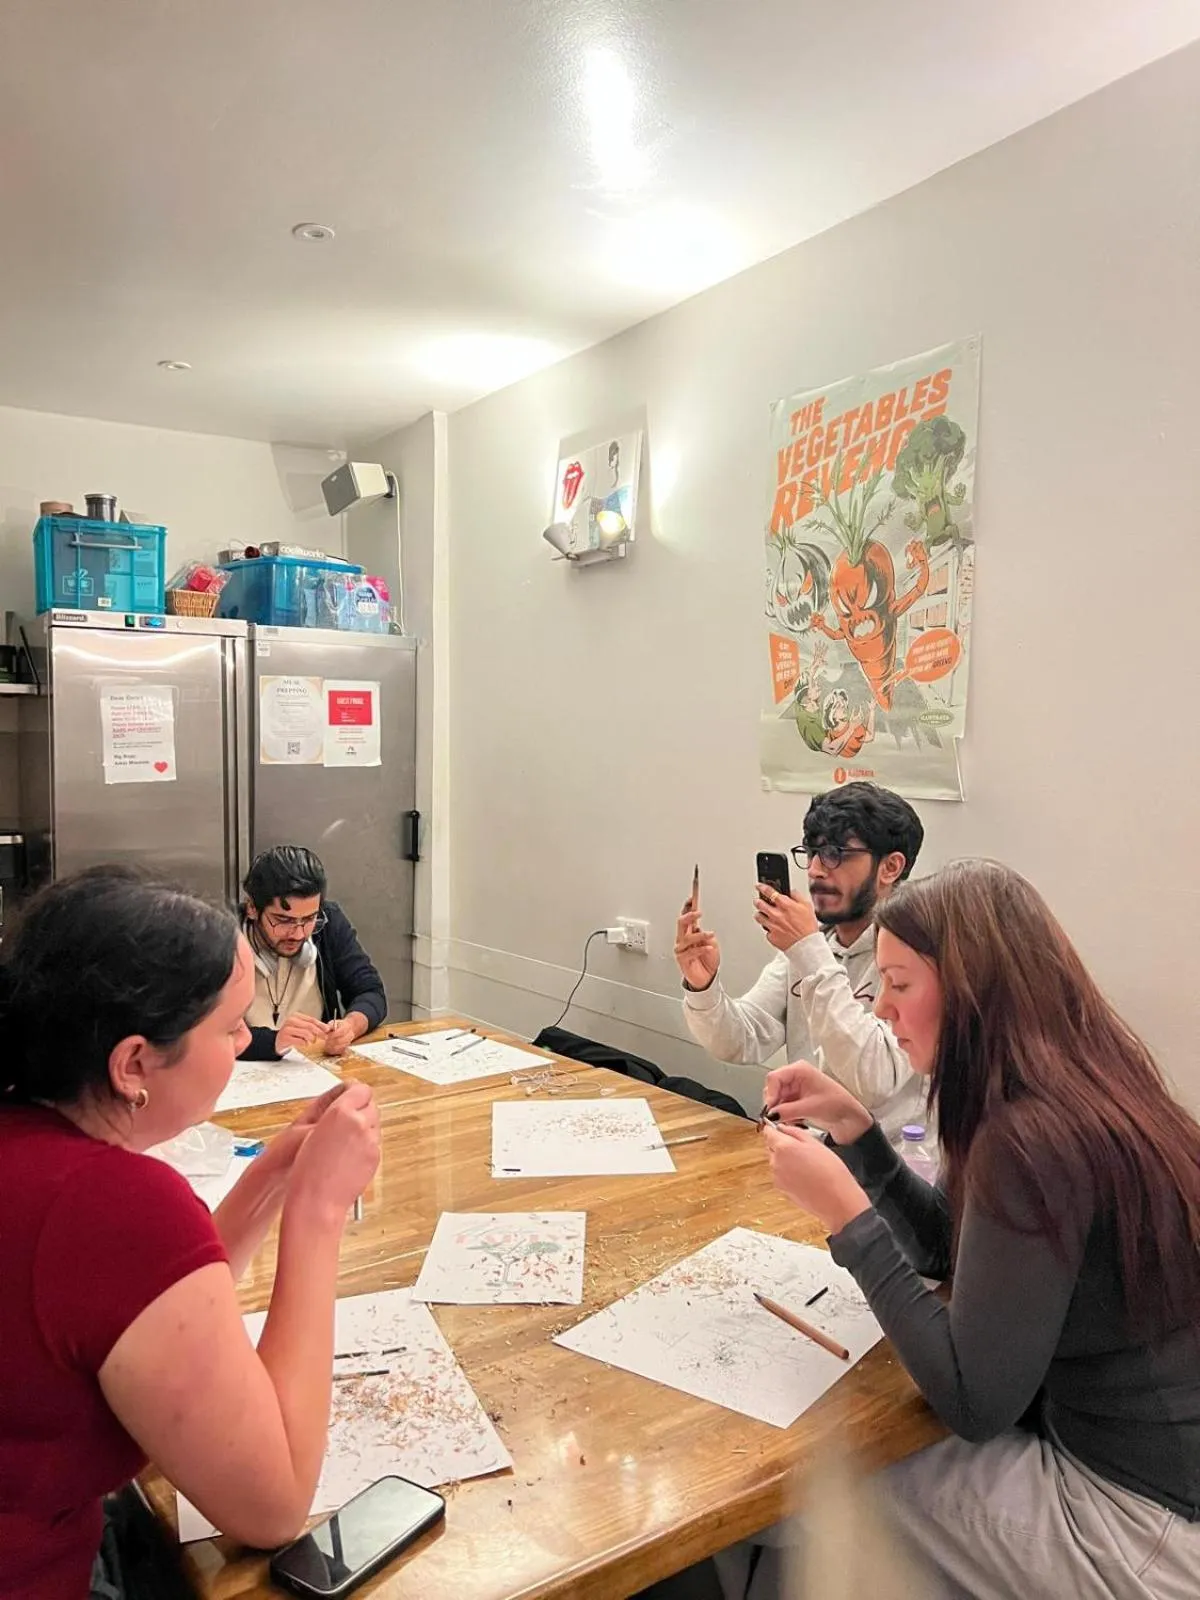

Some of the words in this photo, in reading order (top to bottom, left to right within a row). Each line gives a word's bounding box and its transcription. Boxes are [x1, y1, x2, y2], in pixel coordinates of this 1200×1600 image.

[770, 402, 947, 535] REVENG
[777, 368, 953, 486] VEGETABLES
[790, 396, 826, 436] THE
